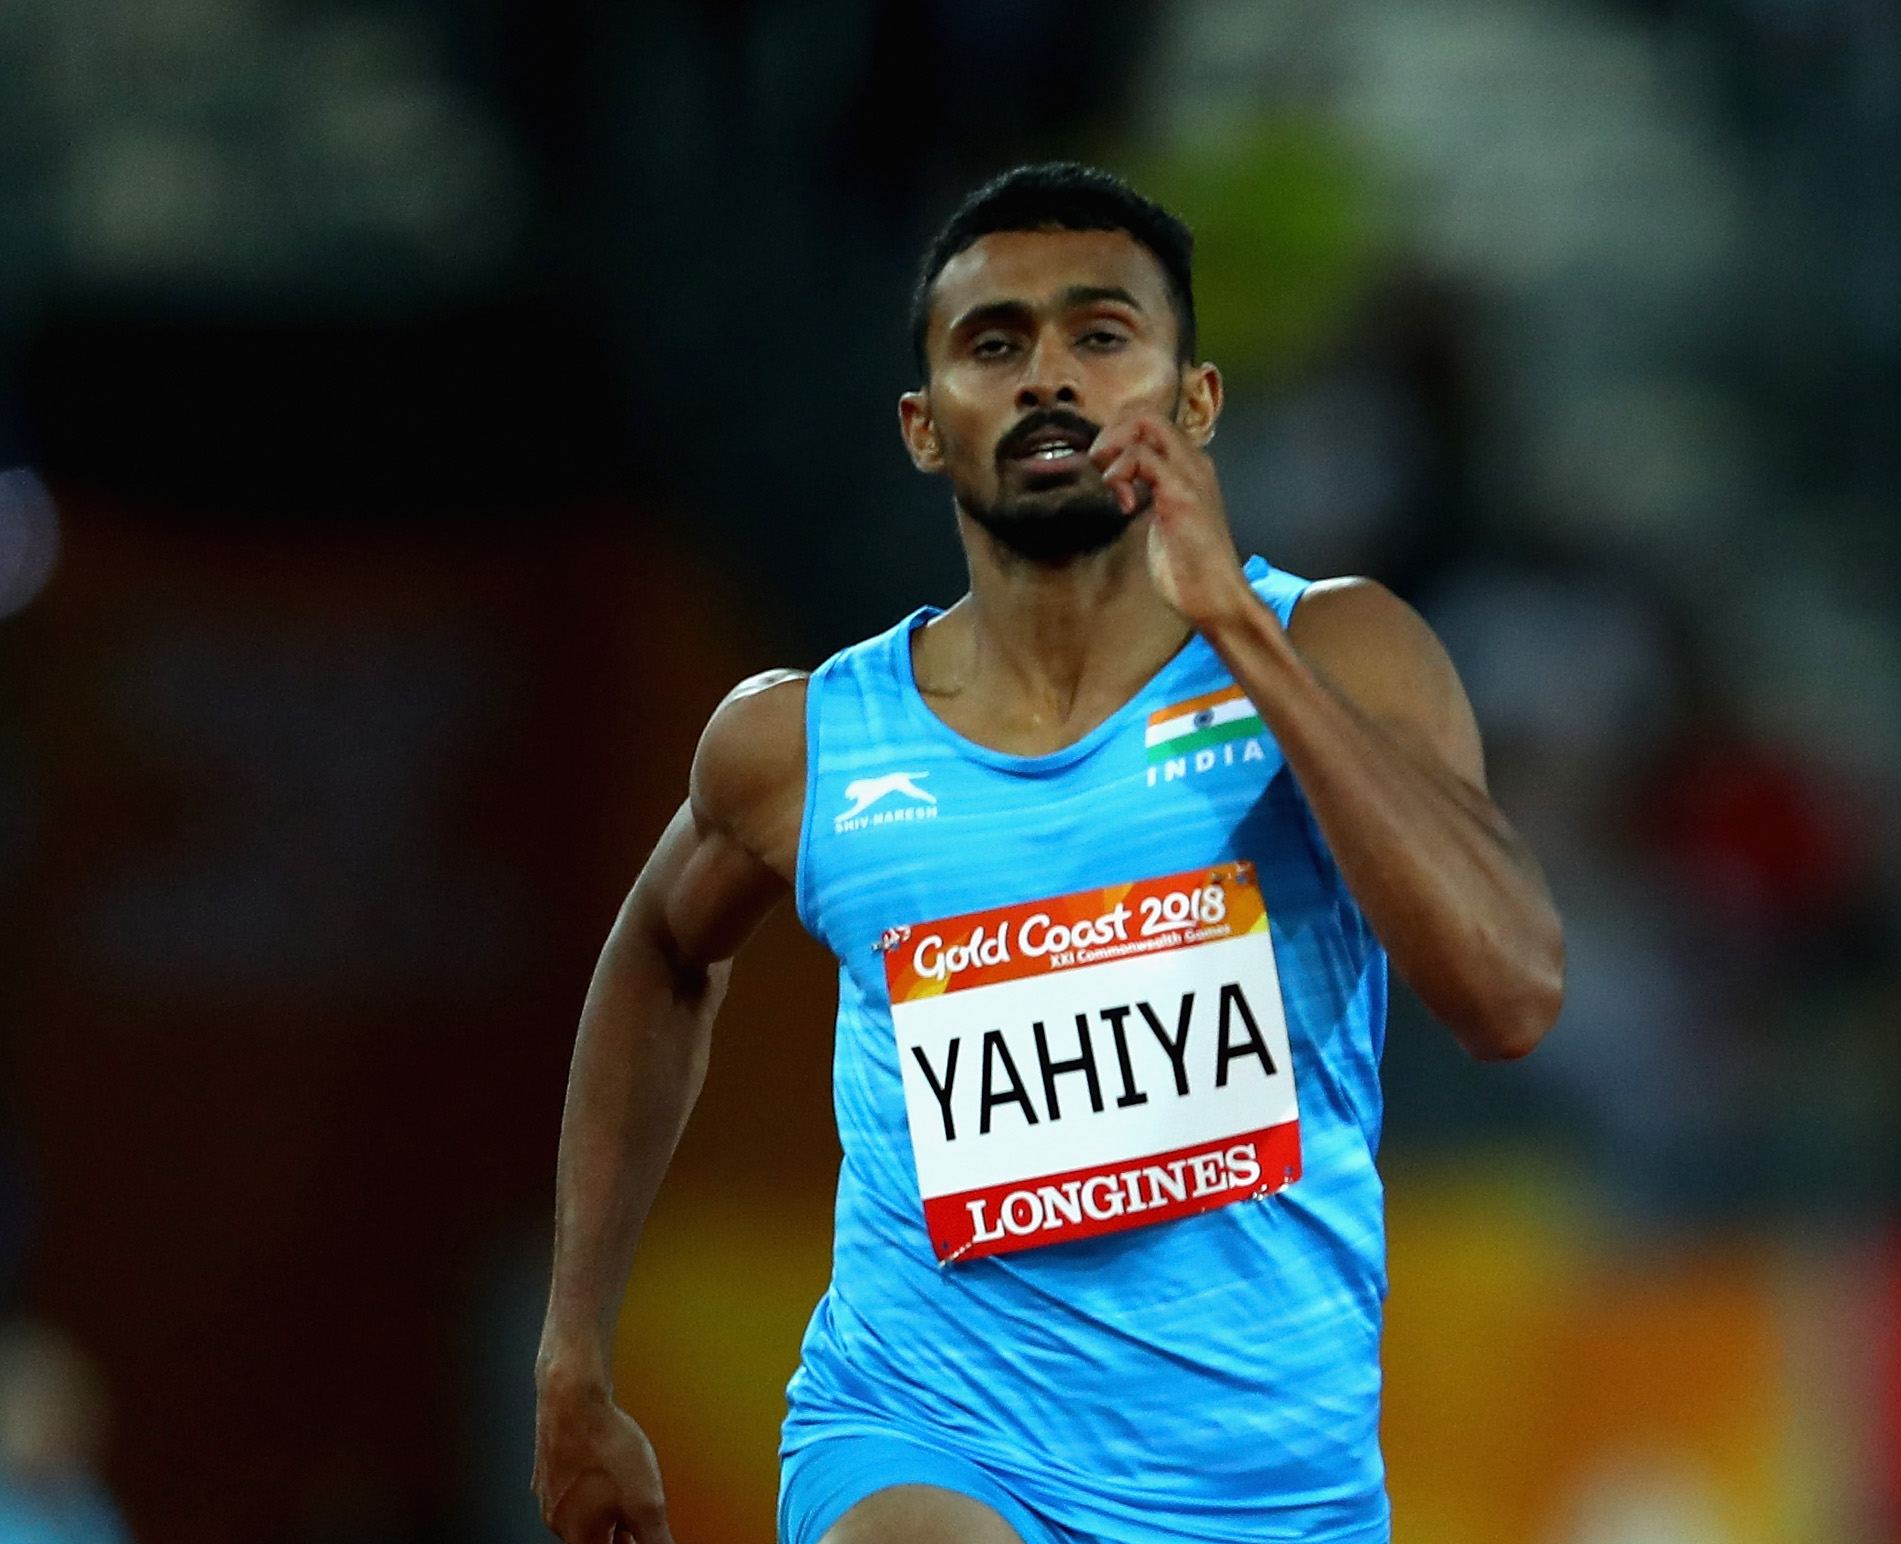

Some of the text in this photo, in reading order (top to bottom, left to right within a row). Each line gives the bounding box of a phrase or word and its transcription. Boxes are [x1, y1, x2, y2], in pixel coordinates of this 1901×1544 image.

[1146, 738, 1265, 788] INDIA
[913, 883, 1227, 981] Gold Coast 2018
[1050, 923, 1232, 969] XXI Commonwealth Games
[910, 982, 1278, 1142] YAHIYA
[965, 1142, 1262, 1244] LONGINES
